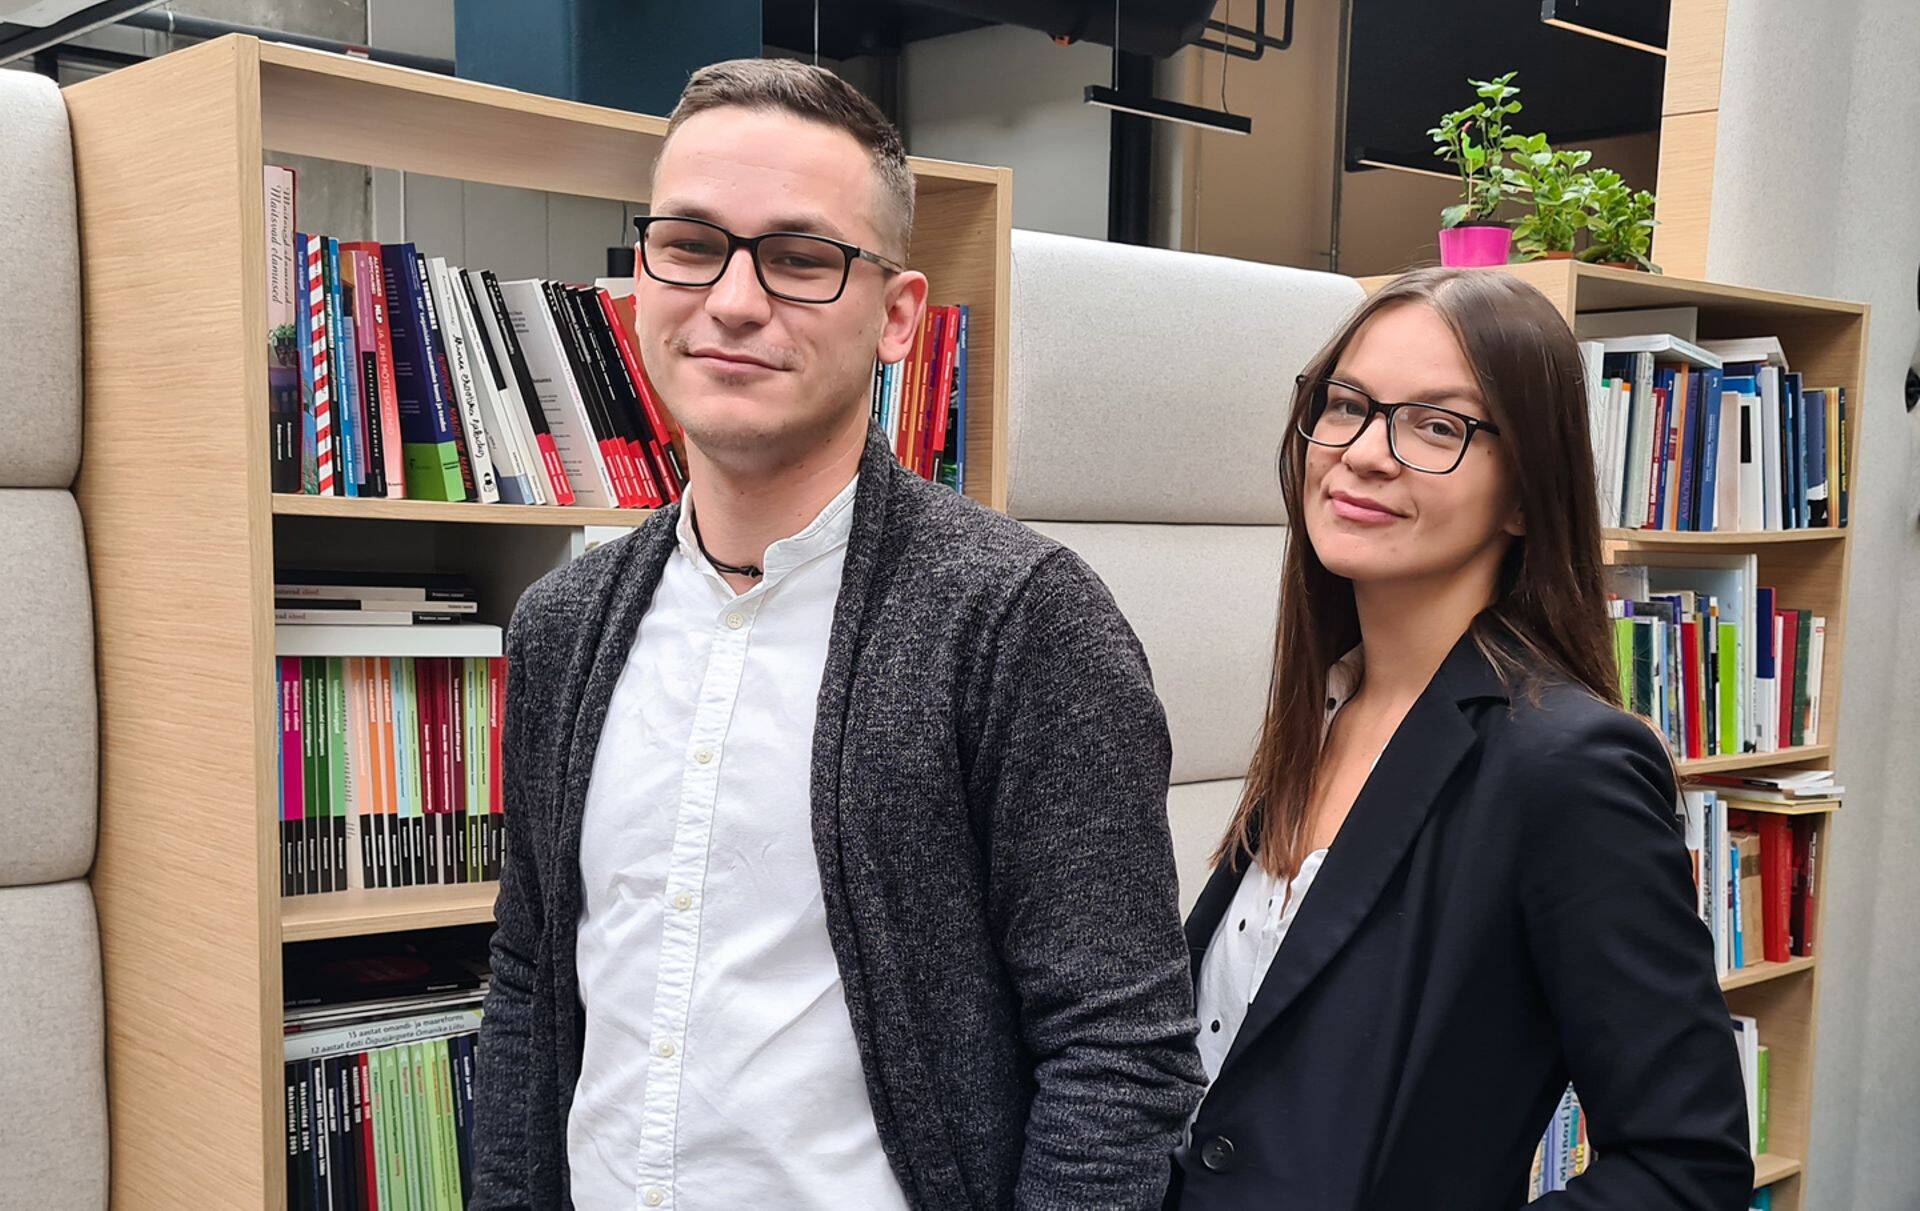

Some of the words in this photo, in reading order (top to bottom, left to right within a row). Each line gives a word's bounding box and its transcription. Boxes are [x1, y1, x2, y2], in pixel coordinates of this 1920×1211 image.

[358, 1026, 381, 1037] aastat
[414, 1020, 421, 1028] ja
[319, 1041, 345, 1052] aastat
[345, 1038, 363, 1048] Eesti
